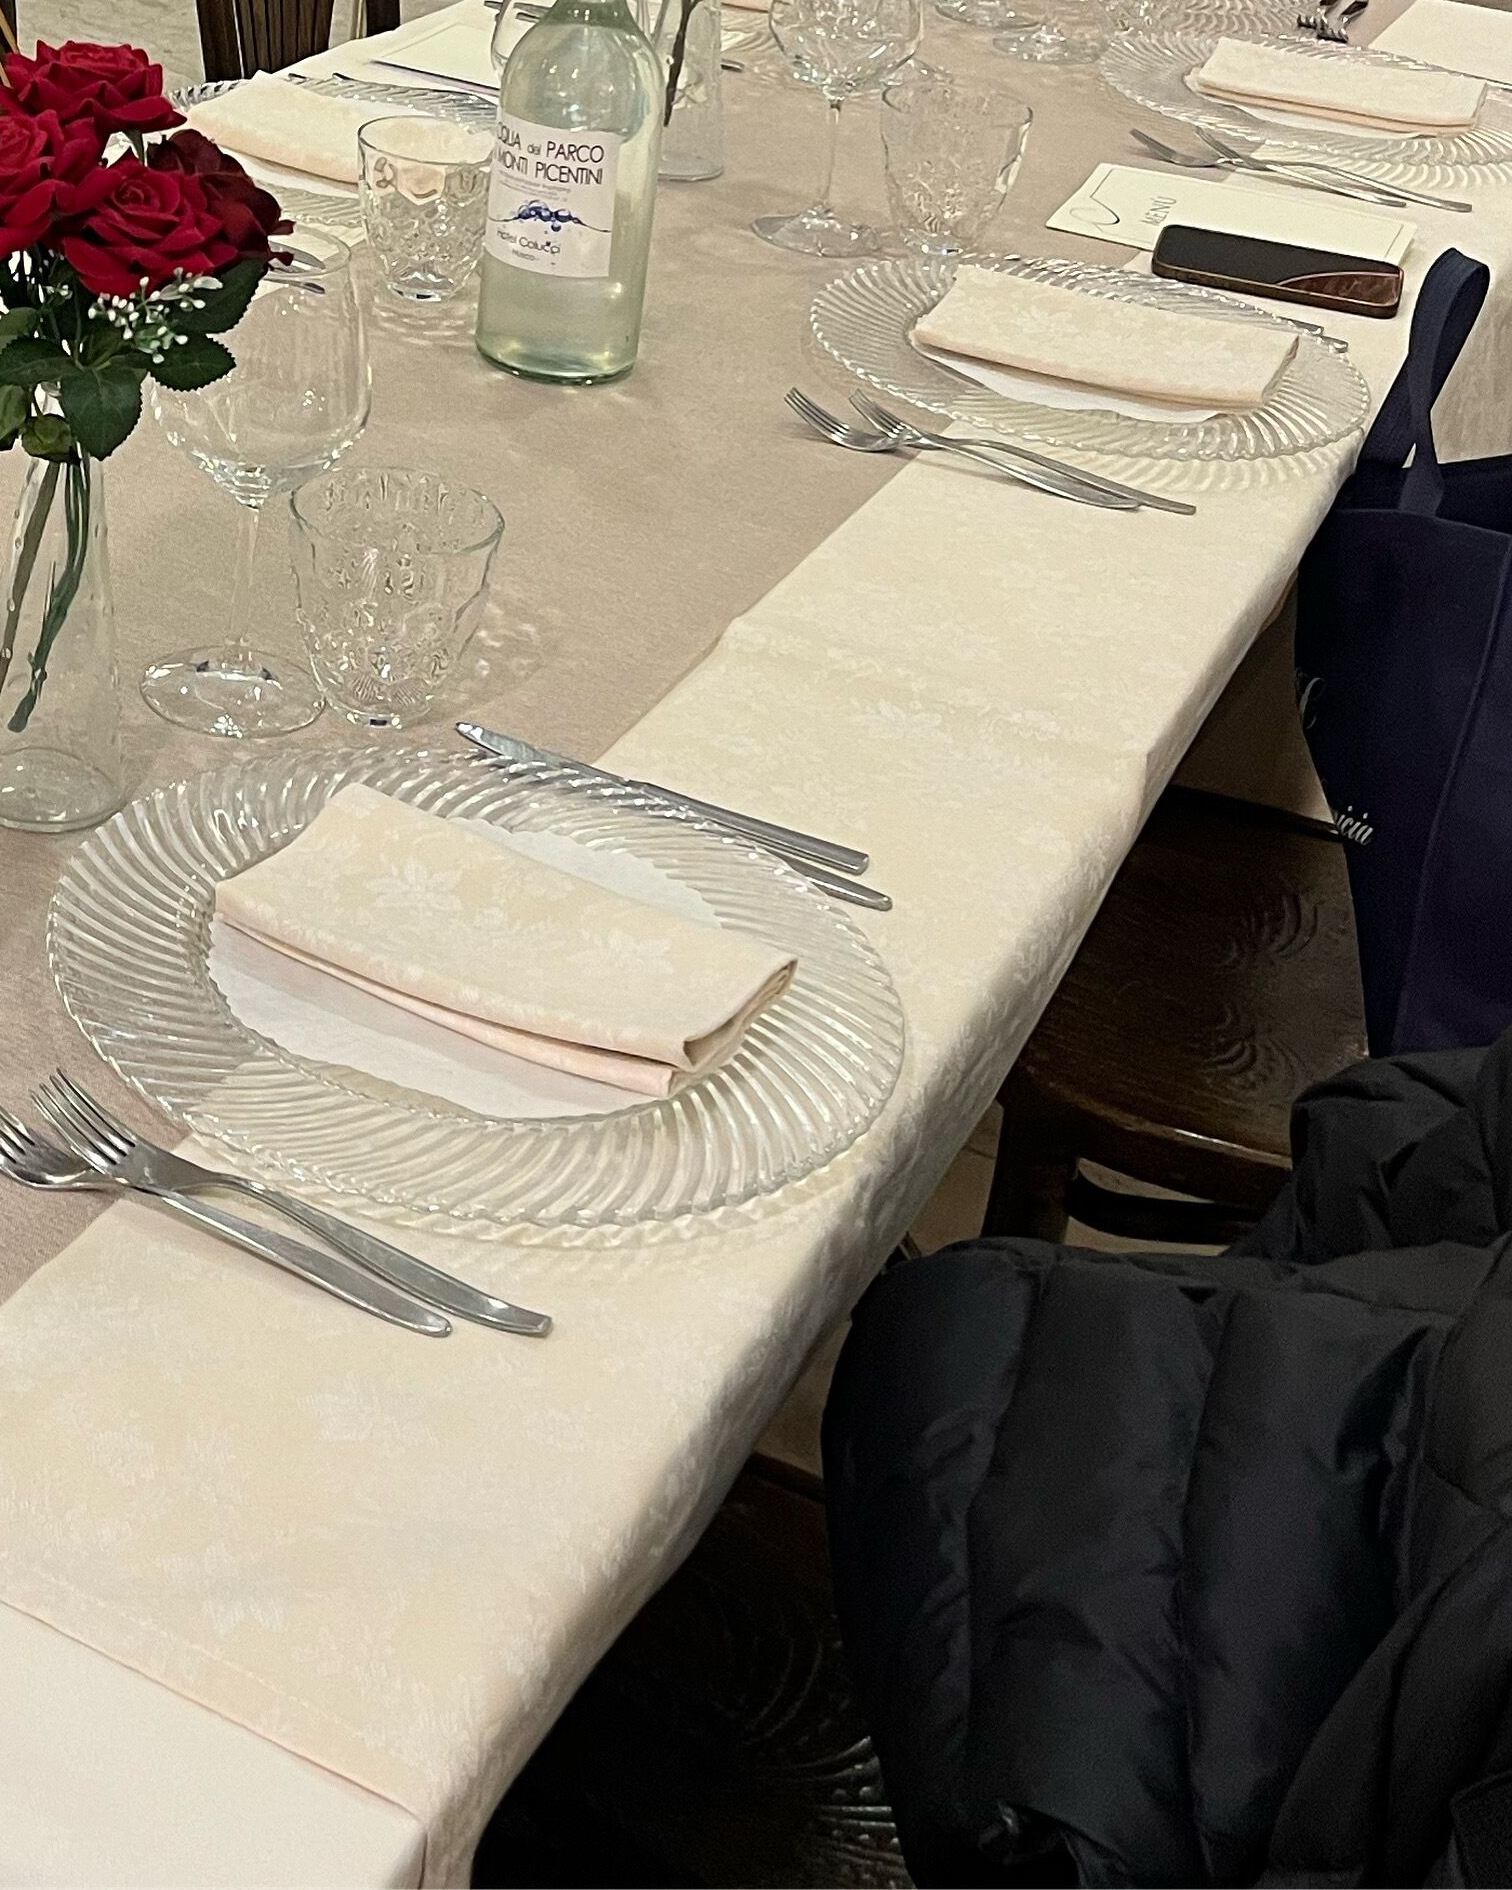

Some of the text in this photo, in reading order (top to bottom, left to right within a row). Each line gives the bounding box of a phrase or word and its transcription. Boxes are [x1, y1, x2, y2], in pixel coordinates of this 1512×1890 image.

[496, 121, 522, 151] CQUA
[546, 140, 605, 164] PARCO
[535, 161, 604, 185] PICENTINI
